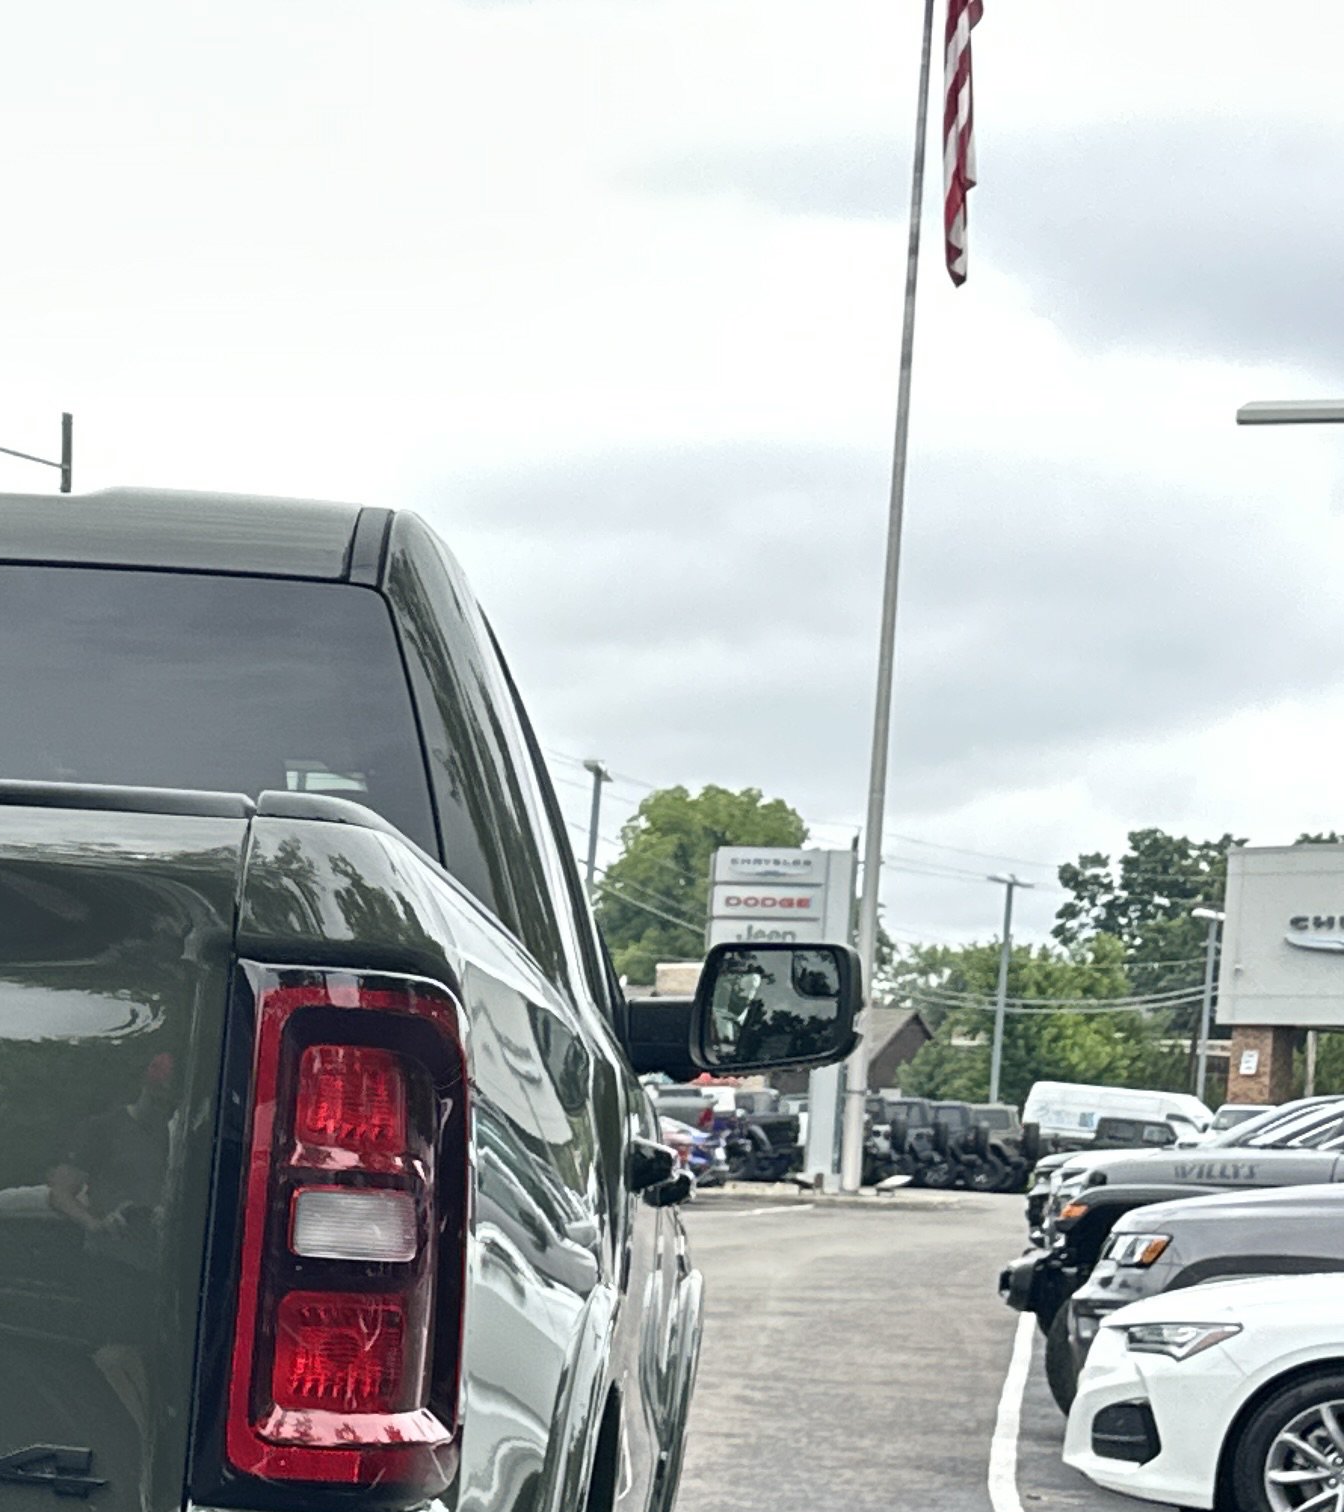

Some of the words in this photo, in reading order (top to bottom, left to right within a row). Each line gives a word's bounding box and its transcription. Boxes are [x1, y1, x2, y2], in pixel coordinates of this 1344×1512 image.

[724, 895, 811, 909] DODGE
[1289, 914, 1344, 931] CH
[1174, 1162, 1261, 1181] WILLYS
